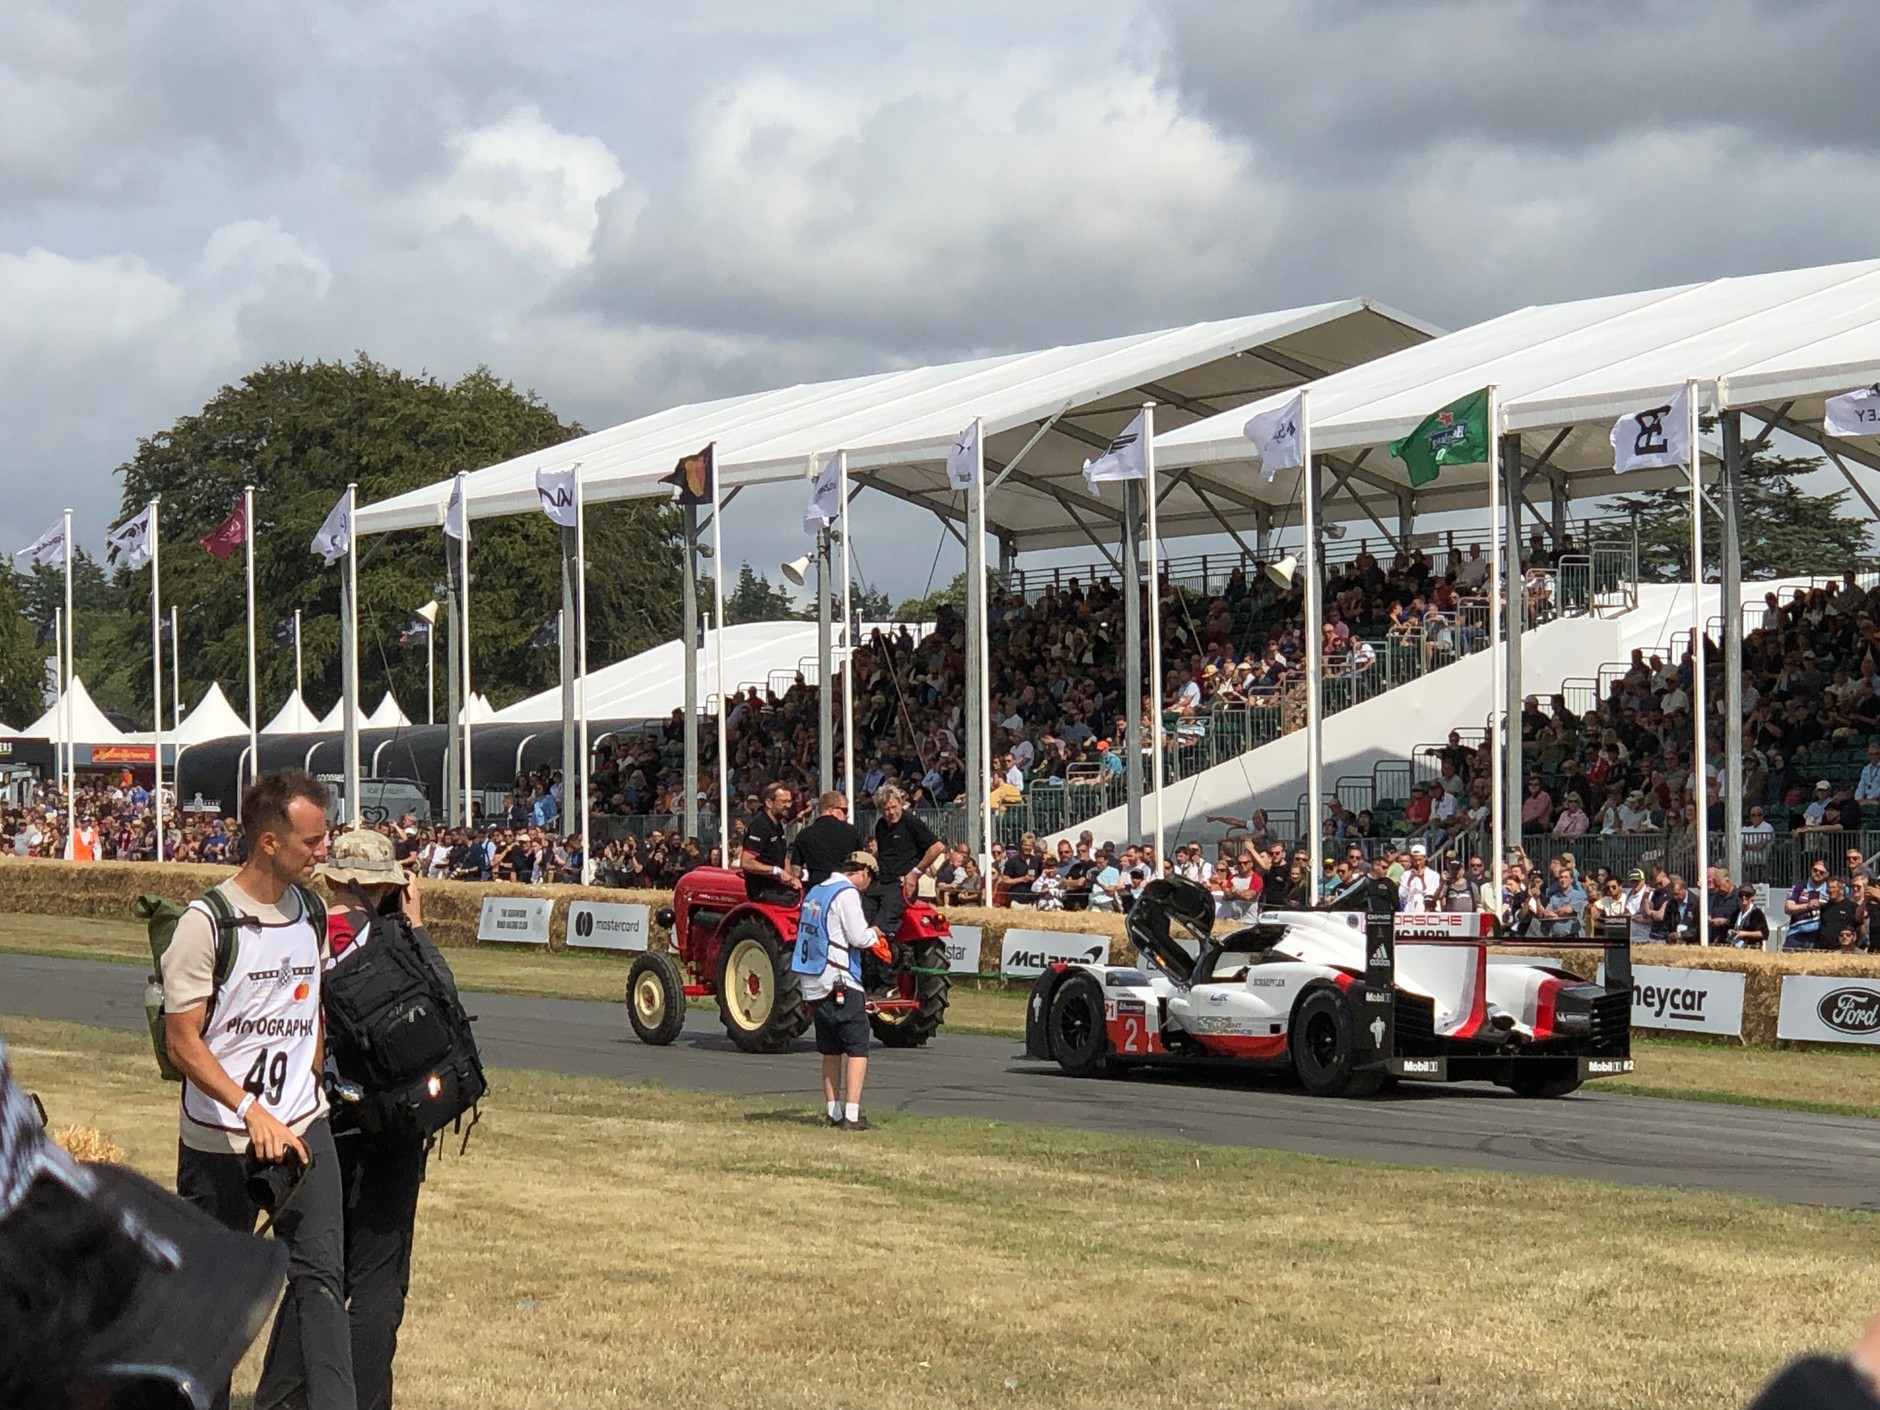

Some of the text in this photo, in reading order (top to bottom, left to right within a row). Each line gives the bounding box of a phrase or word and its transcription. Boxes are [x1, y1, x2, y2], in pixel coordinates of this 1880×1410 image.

[595, 919, 640, 933] mastercard
[1365, 992, 1385, 1002] Mobil
[1832, 993, 1878, 1026] Ford
[1124, 1017, 1138, 1052] 2
[1403, 1061, 1429, 1072] Mobil
[1588, 1061, 1613, 1072] Mobil
[243, 1047, 288, 1106] 49
